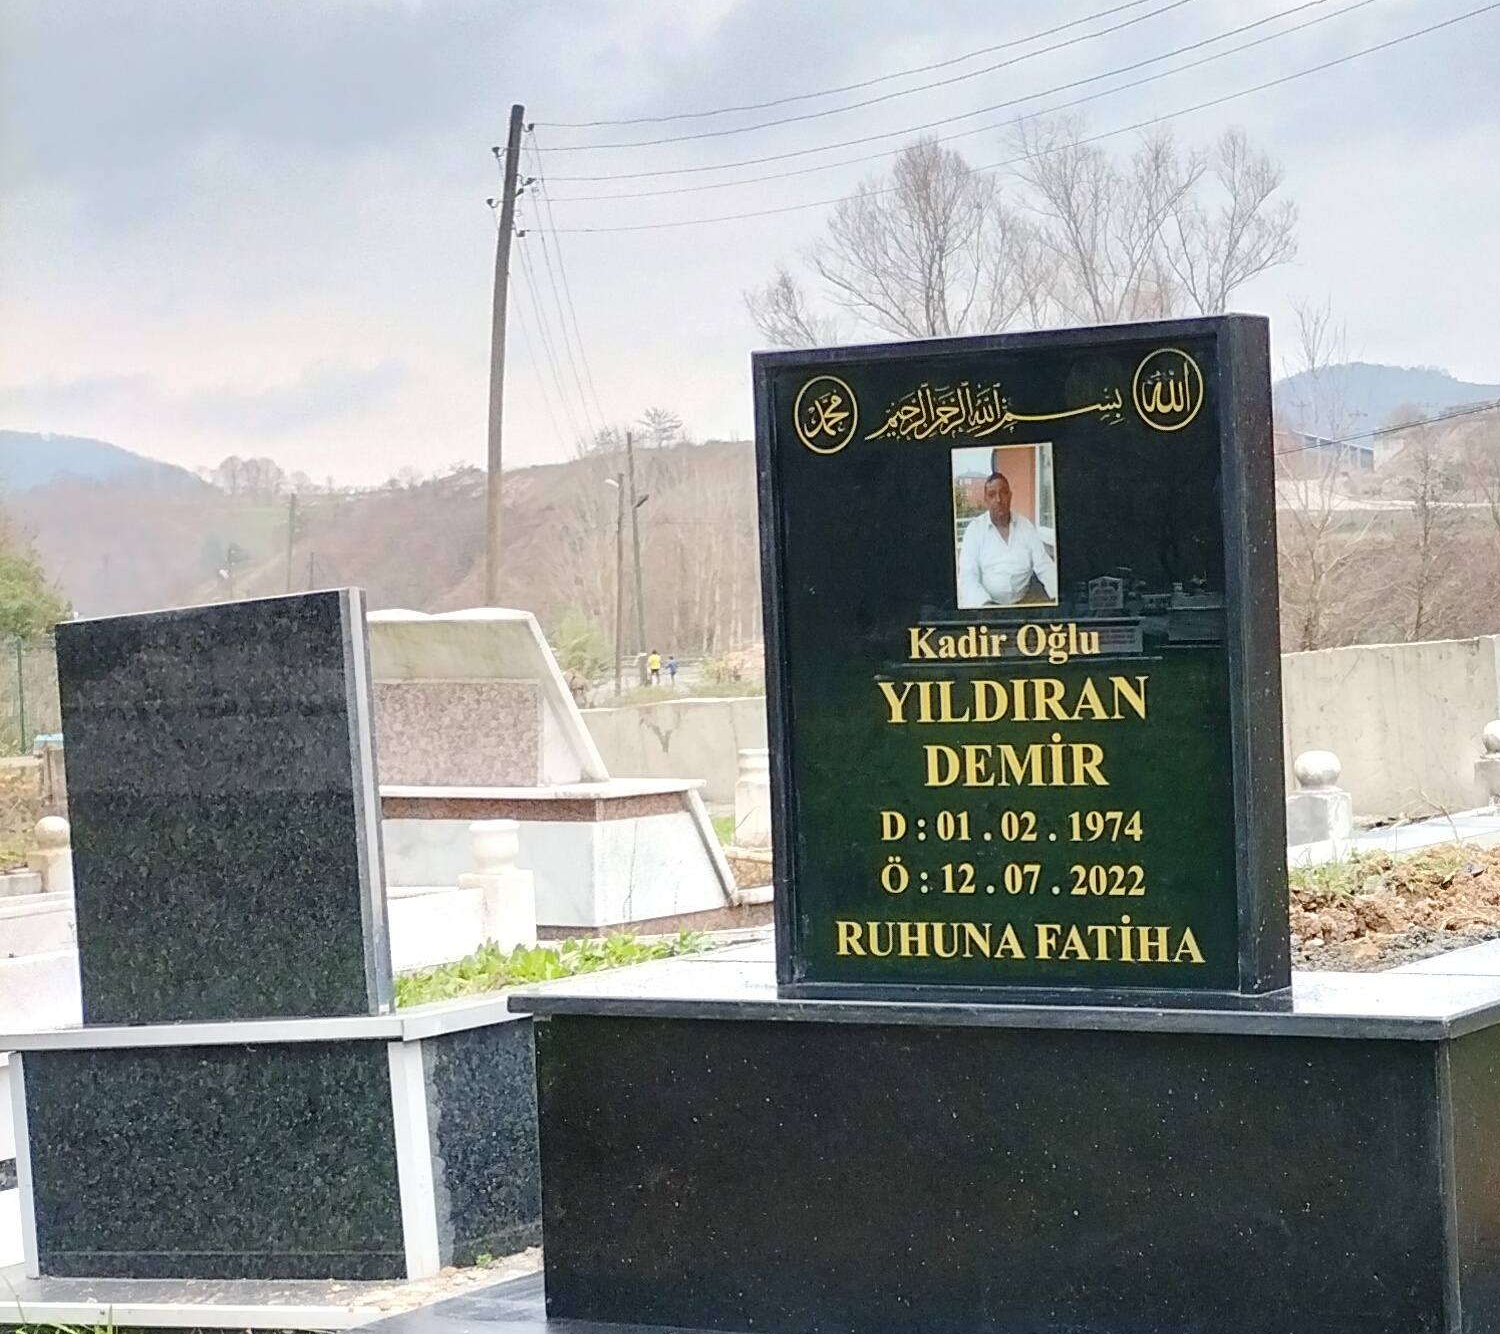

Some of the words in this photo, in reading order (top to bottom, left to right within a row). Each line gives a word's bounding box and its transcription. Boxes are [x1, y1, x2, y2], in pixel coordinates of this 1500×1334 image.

[909, 626, 1008, 660] Kadir
[1016, 623, 1100, 665] Oğlu
[878, 676, 1148, 724] YILDIRAN
[923, 732, 1110, 787] DEMİR
[836, 921, 1027, 959] RUHUNA
[1034, 914, 1206, 964] FATİHA
